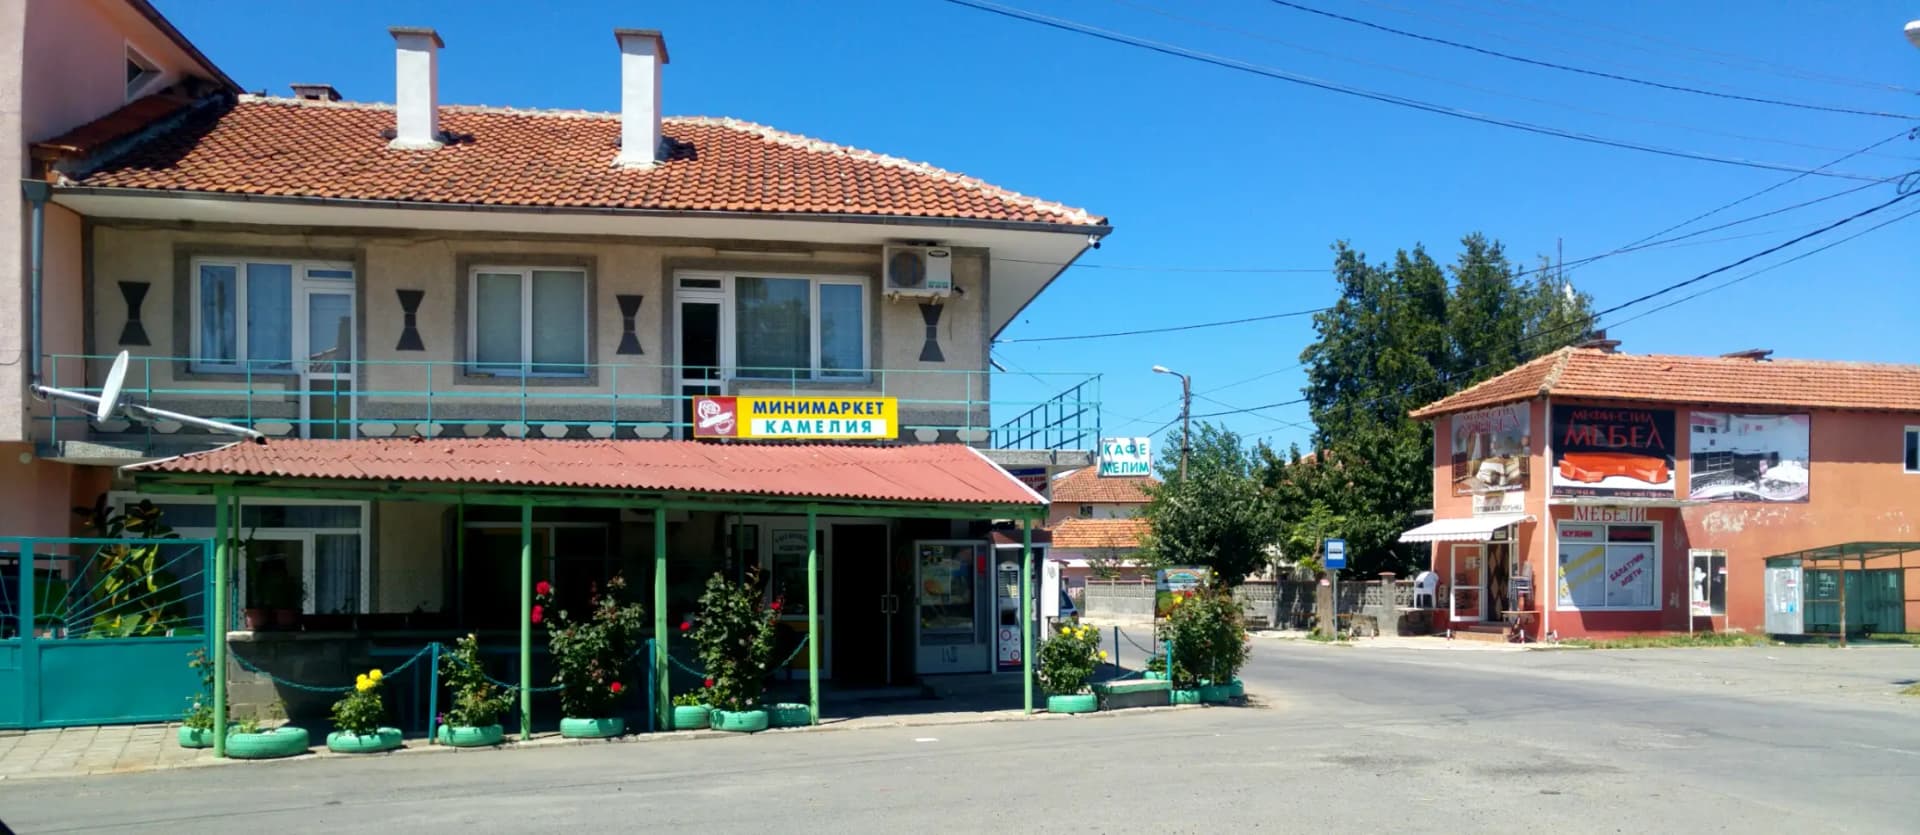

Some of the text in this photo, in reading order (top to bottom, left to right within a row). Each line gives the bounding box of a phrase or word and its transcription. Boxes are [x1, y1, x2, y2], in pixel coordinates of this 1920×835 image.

[752, 400, 885, 415] МИНИМАРКЕТ
[765, 420, 873, 434] КАМЕЛИЯ
[1563, 423, 1665, 449] МЕБЕЛ
[1103, 443, 1147, 456] КАФЕ
[1575, 505, 1647, 521] МЕБЕЛИ
